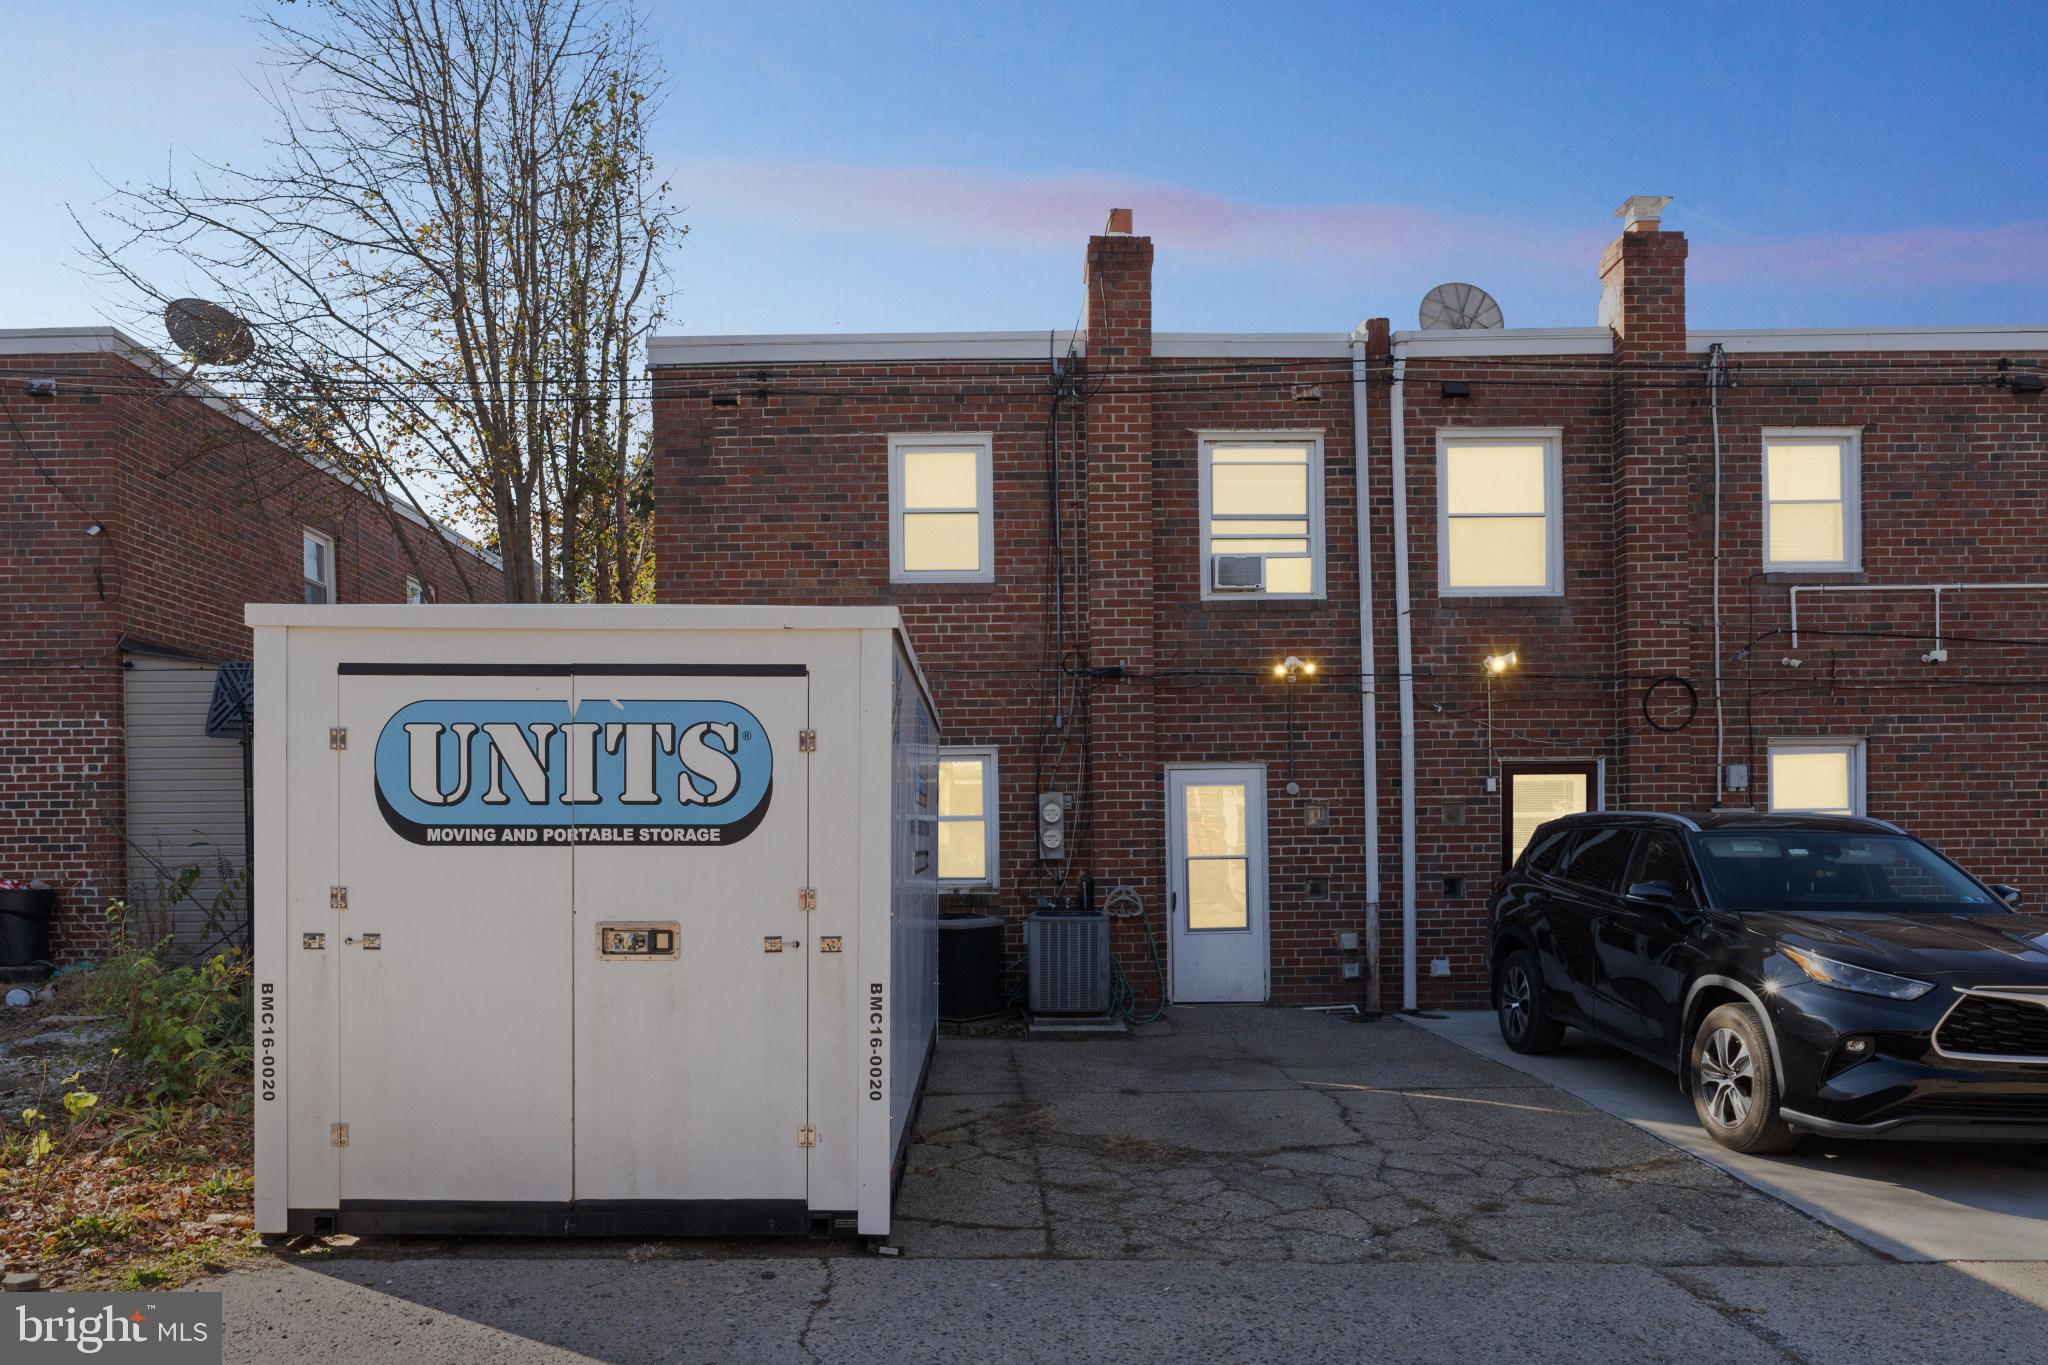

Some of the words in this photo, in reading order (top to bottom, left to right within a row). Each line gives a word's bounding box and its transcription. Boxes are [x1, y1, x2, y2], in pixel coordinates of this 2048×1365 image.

[402, 721, 741, 807] UNITS
[426, 828, 496, 842] MOVING
[501, 828, 538, 842] AND
[543, 828, 634, 842] PORTABLE
[639, 828, 721, 842] STORAGE
[261, 983, 275, 1101] BMC16-0020
[869, 983, 883, 1101] BMC16-0020
